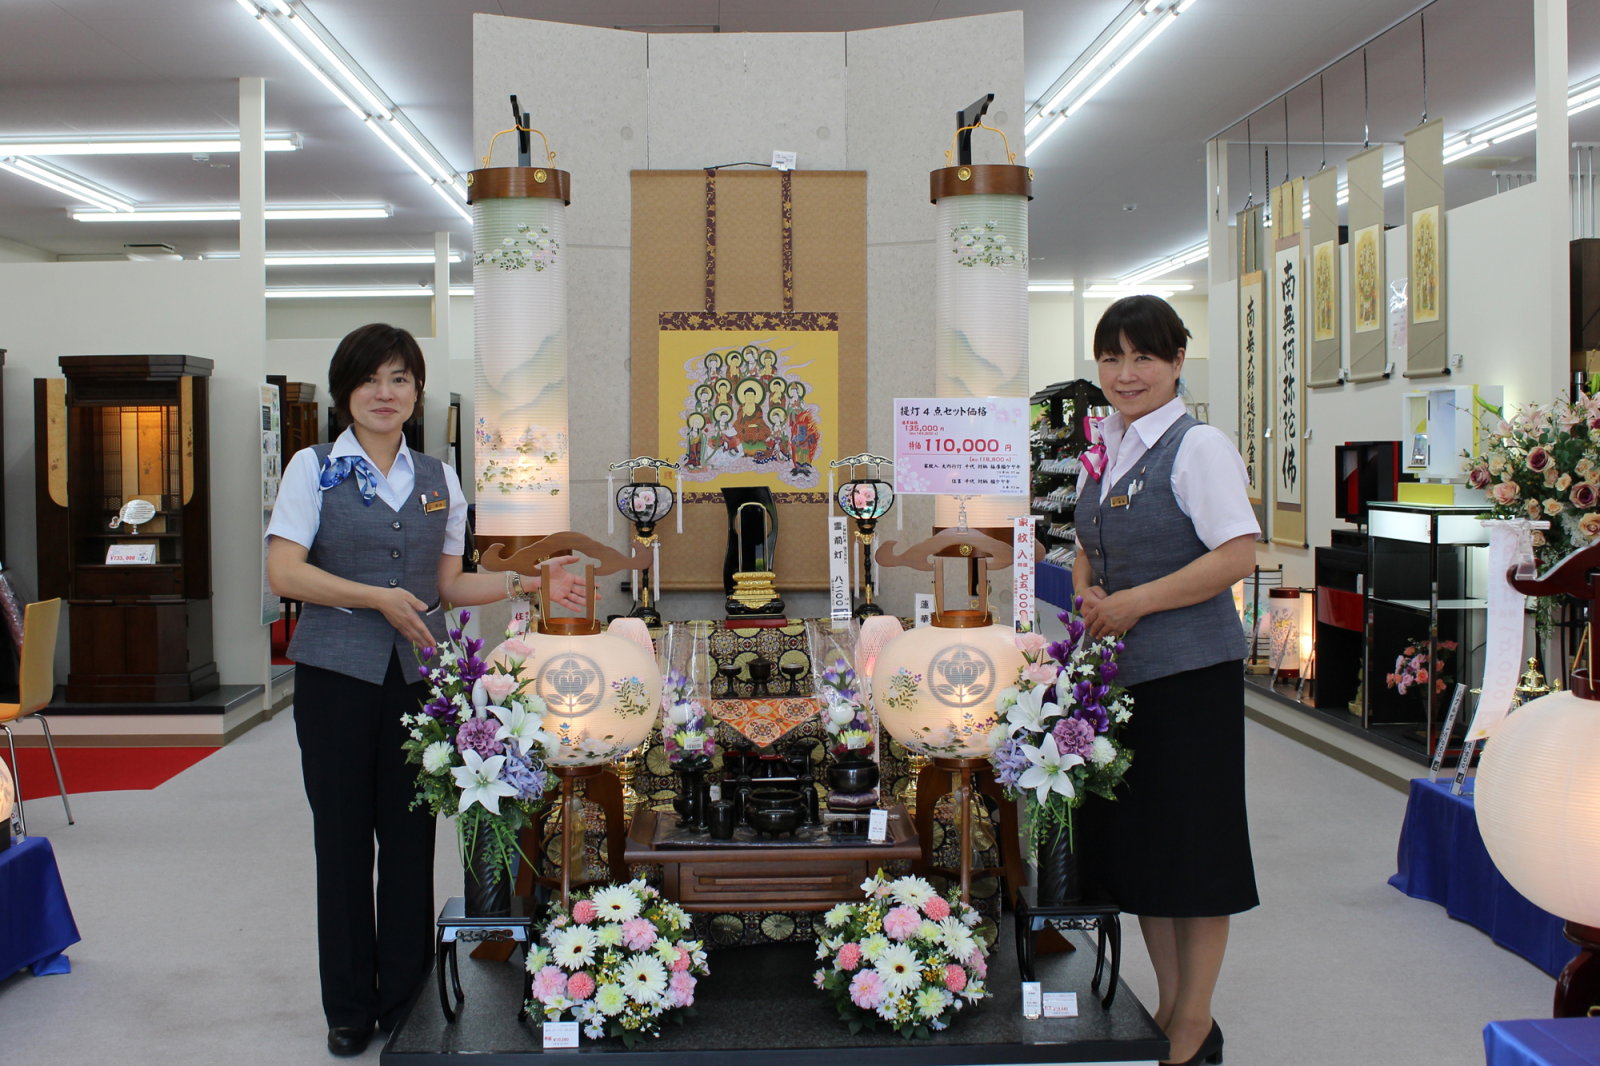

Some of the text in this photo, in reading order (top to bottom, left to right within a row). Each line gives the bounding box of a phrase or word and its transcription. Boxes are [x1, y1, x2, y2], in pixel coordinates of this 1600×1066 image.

[908, 438, 1012, 454] 特価 110,000 円
